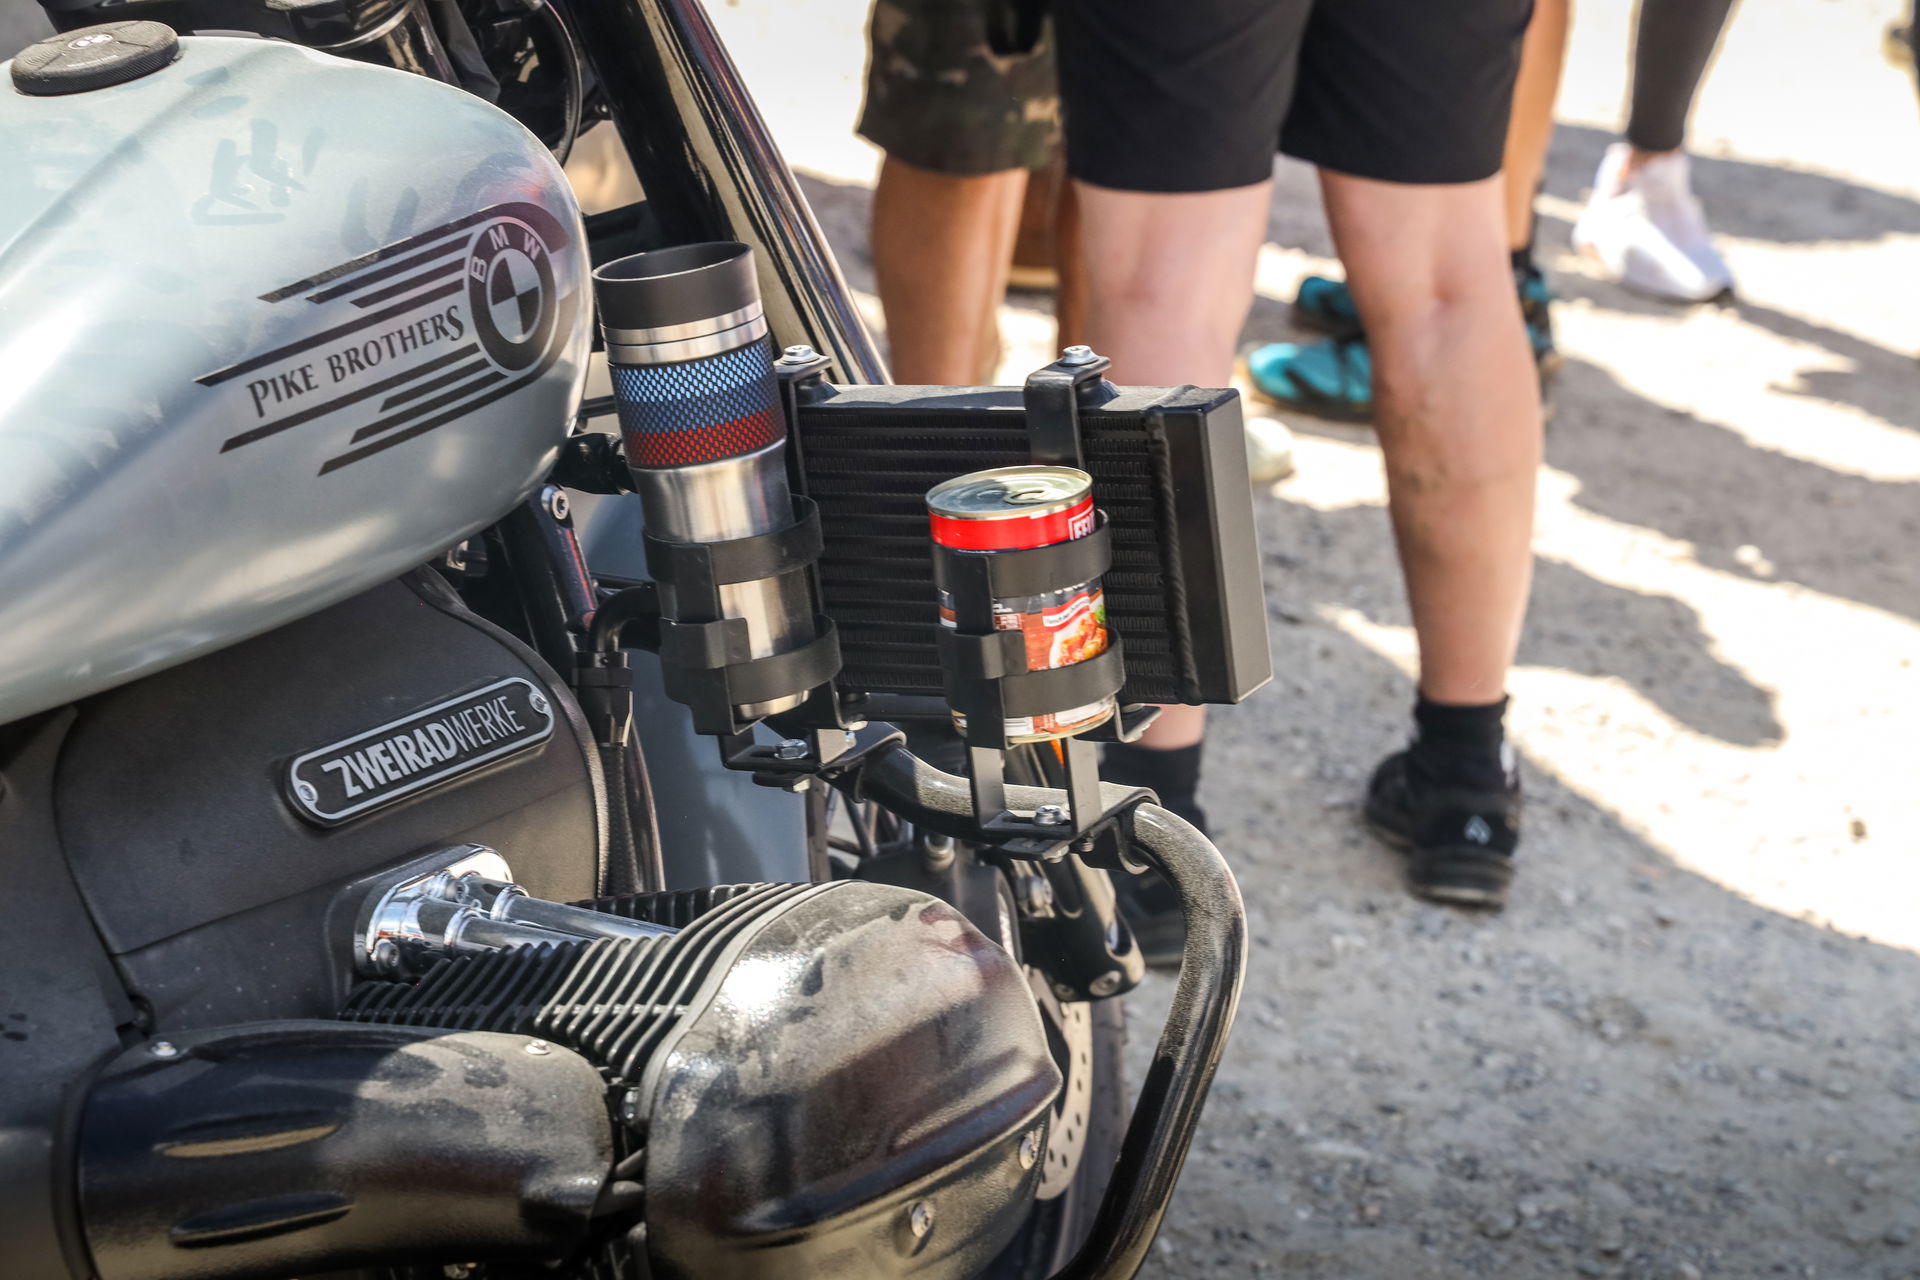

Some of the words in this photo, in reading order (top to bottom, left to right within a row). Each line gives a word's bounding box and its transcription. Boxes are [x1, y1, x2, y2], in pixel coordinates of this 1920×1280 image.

[471, 225, 542, 284] BMW
[247, 364, 319, 418] PIKE
[326, 305, 465, 384] BROTHERS
[321, 695, 526, 799] ZWEIRADWERKE
